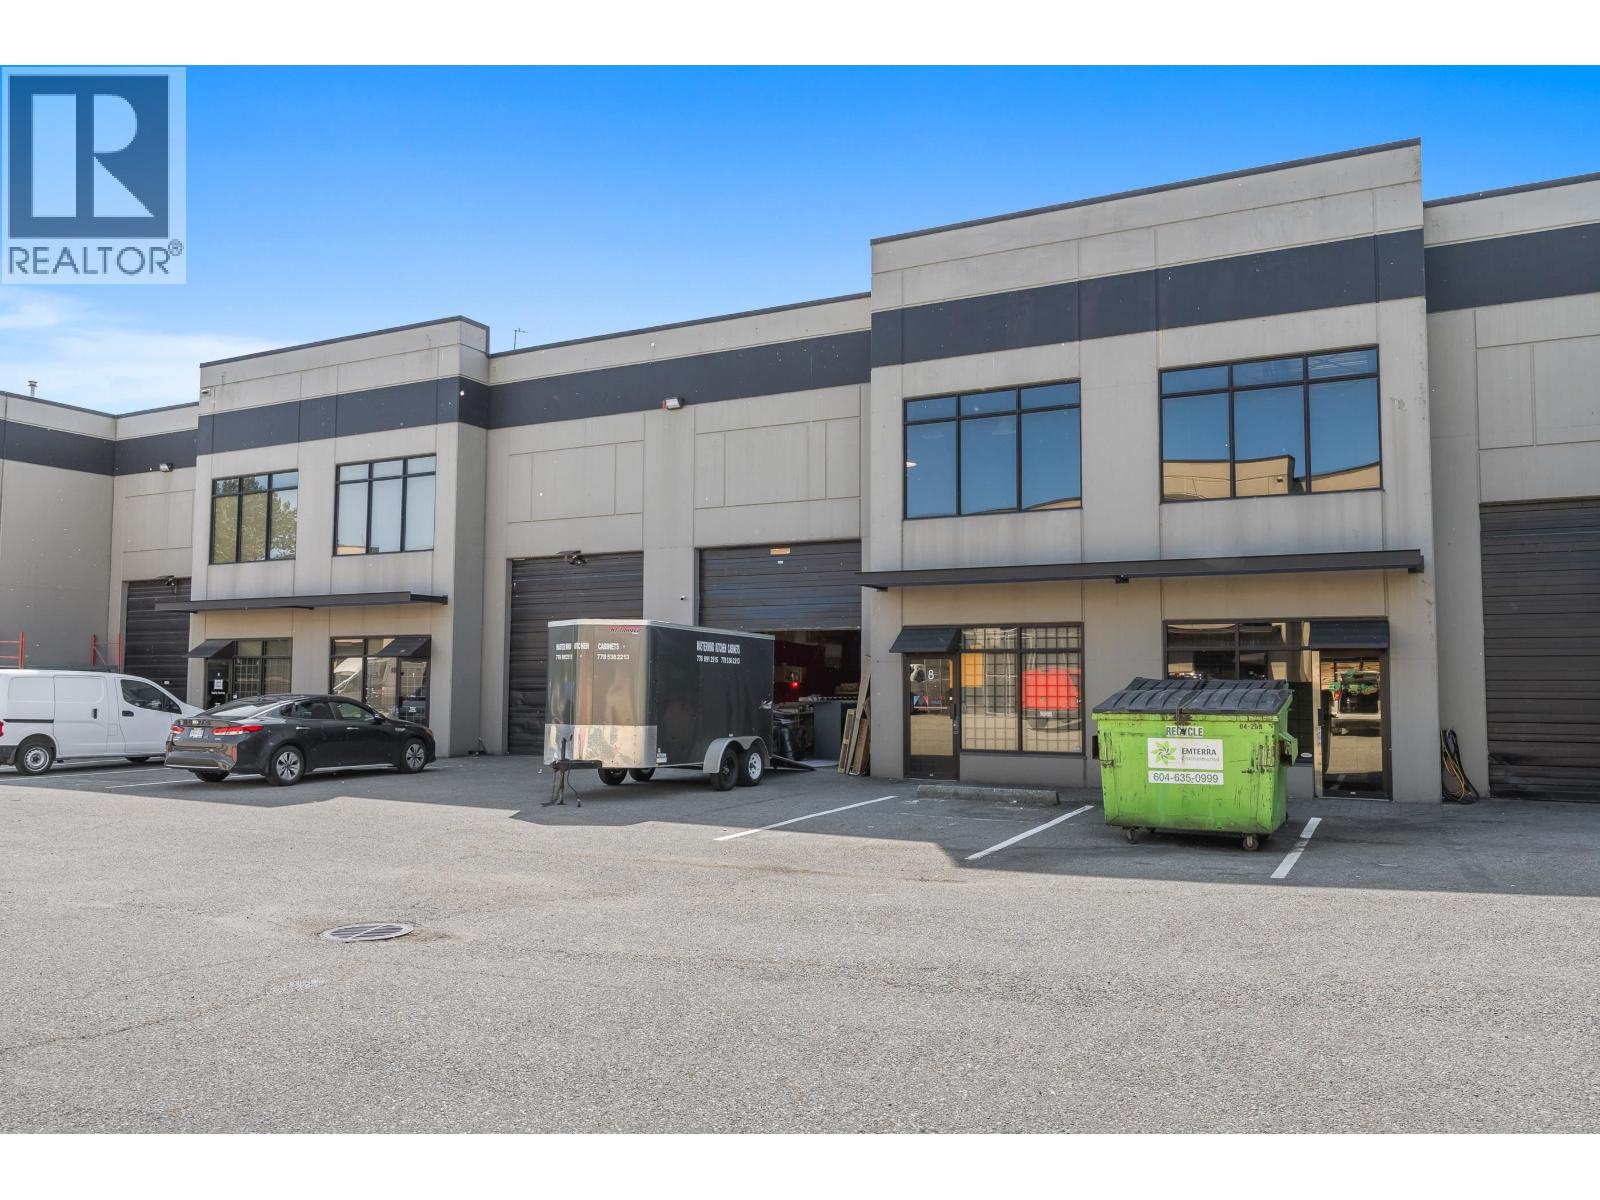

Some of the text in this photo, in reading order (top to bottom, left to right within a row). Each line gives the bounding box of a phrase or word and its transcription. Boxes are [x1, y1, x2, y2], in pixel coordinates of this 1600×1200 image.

[597, 642, 619, 650] CABINETS
[927, 669, 935, 680] 8
[1181, 747, 1217, 756] EMTERRA
[1153, 772, 1219, 783] 604-635-0999
